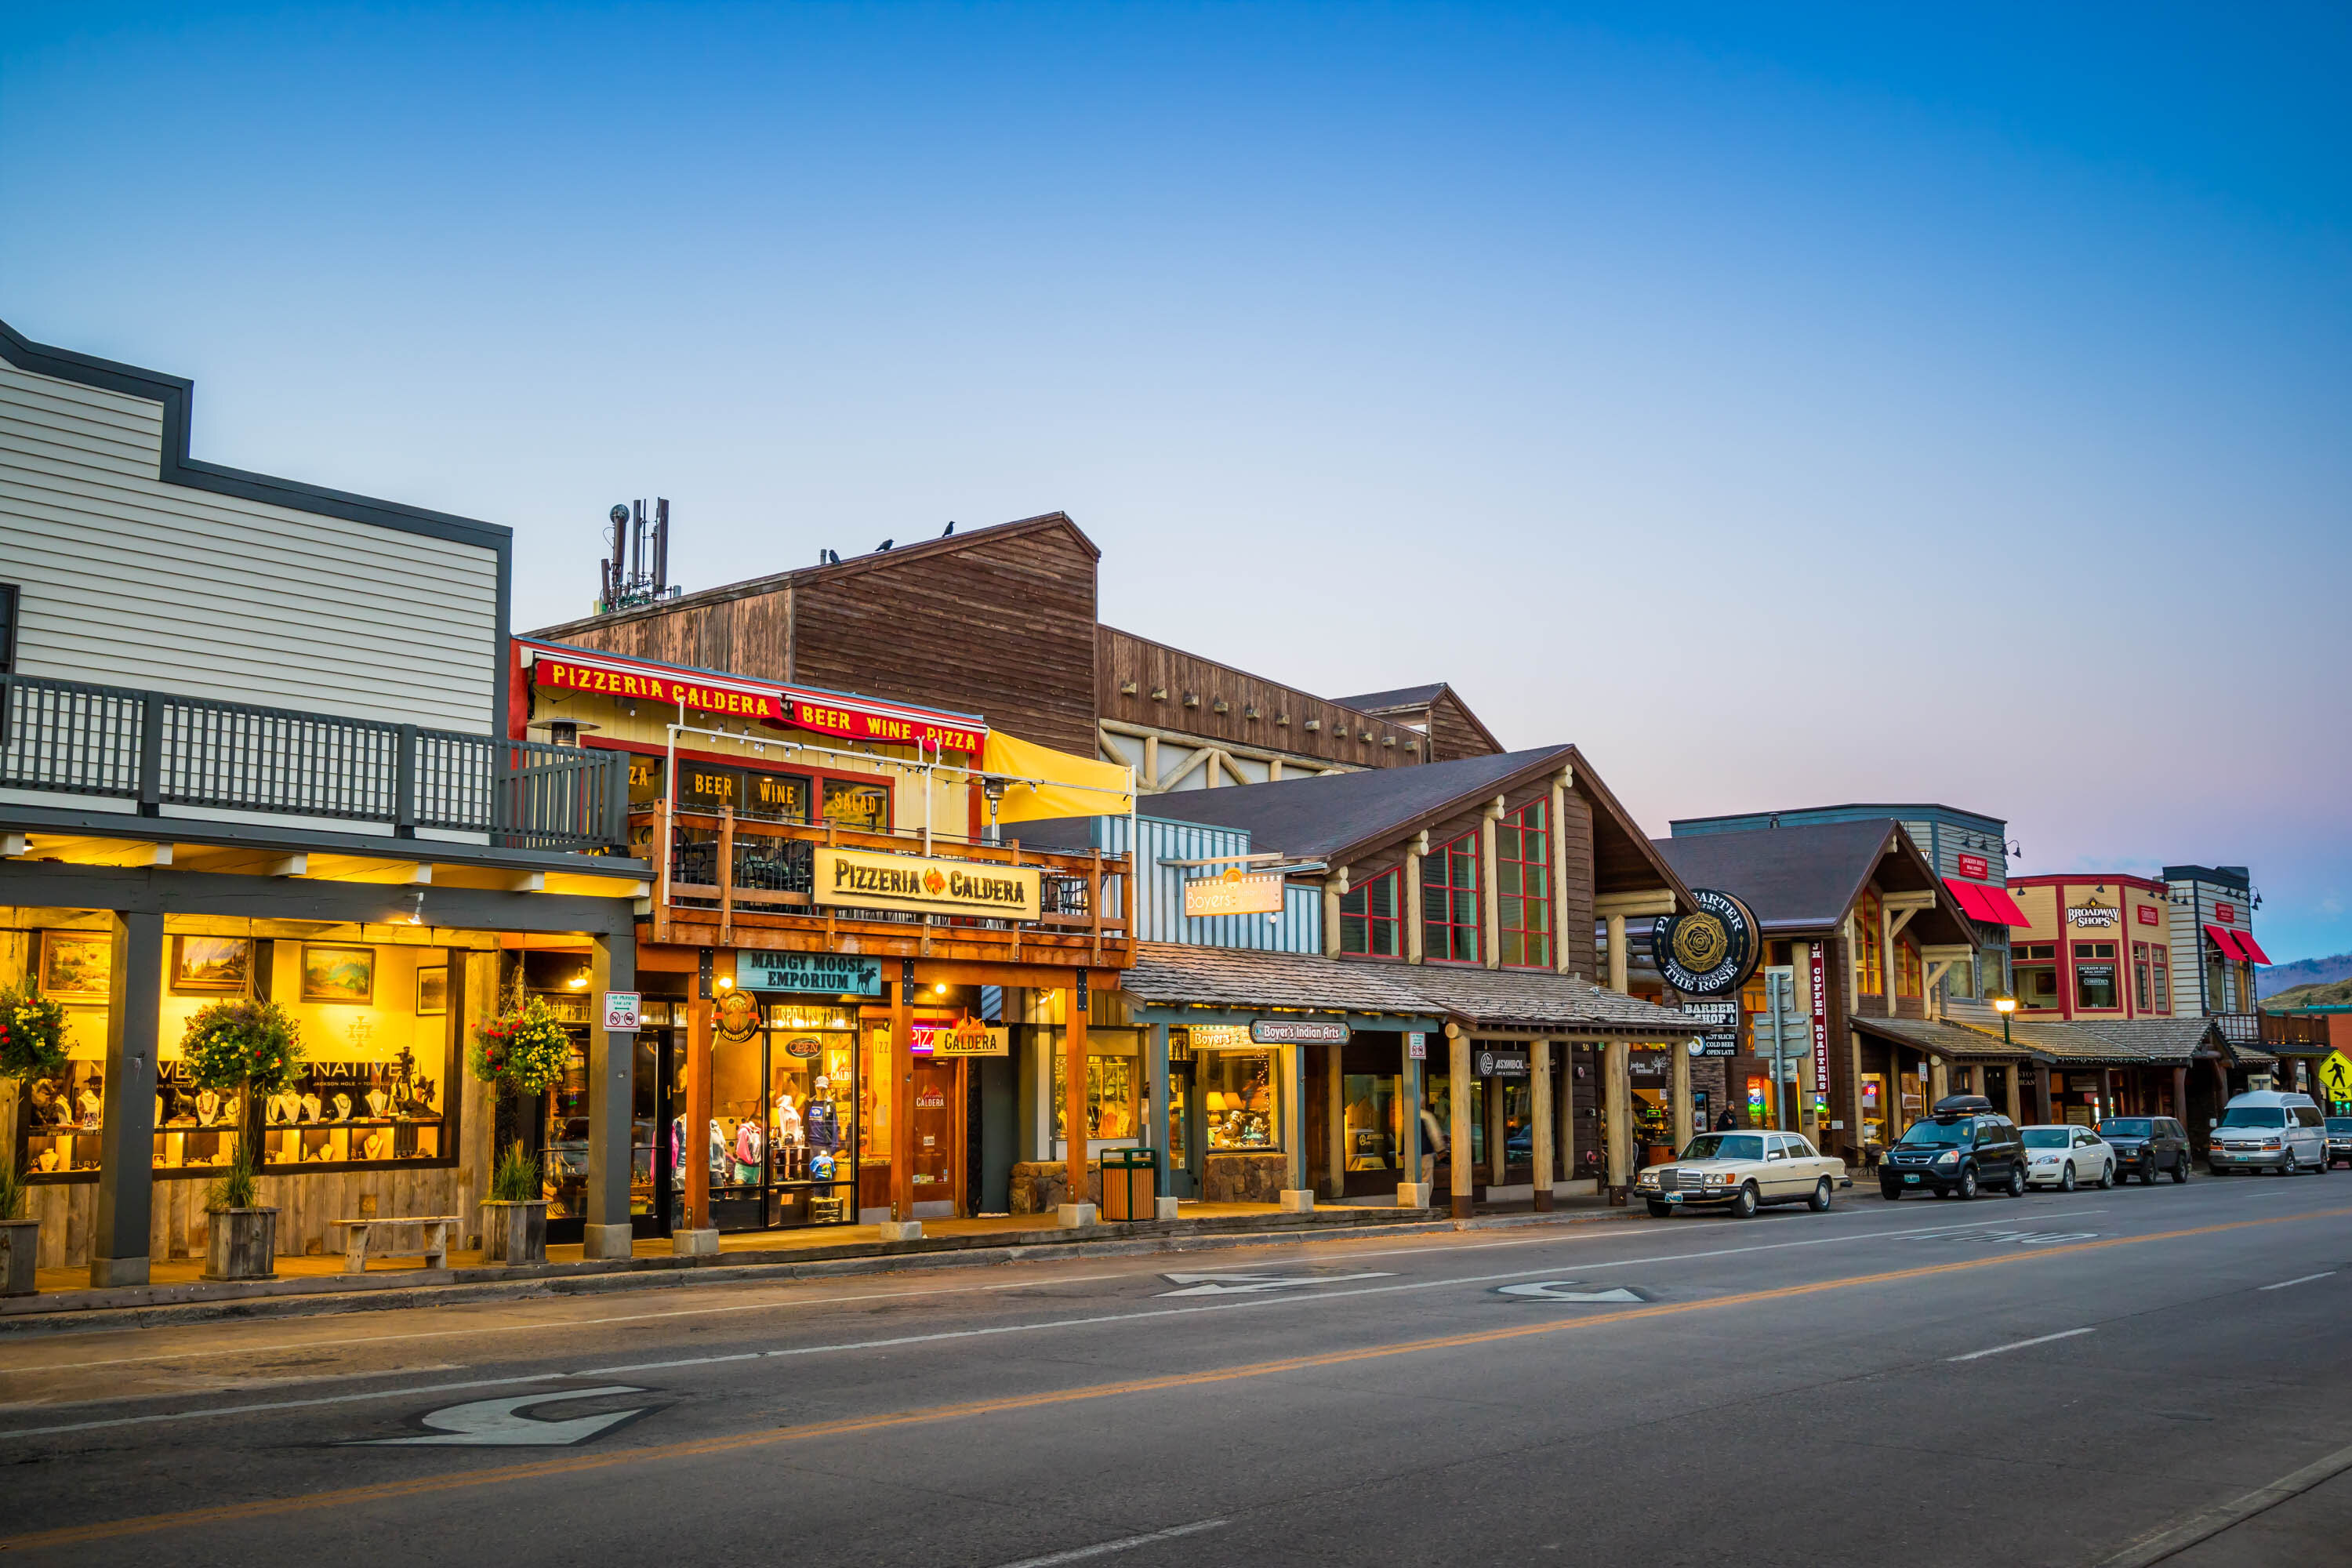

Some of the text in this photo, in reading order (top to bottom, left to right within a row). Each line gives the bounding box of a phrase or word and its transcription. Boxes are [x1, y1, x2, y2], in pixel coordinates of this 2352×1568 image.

[553, 664, 770, 716] PIZZERIA CALDERA
[802, 706, 976, 751] BEER WINE PIZZA
[695, 773, 732, 797] BEER
[760, 783, 794, 804] WINE
[834, 792, 877, 814] SALAD
[835, 858, 1025, 902] PIZZERIA CALDERA
[1186, 890, 1230, 912] Boyer's
[2067, 908, 2120, 924] BROADWAY
[2078, 916, 2111, 927] SHOPS
[1813, 943, 1821, 958] JH
[751, 953, 866, 973] MANGY MOOSE
[768, 971, 849, 989] EMPORIUM
[1664, 964, 1737, 992] THE ROSE
[1813, 967, 1824, 1015] COFFEE
[1685, 1004, 1735, 1014] BARBER
[722, 1029, 750, 1040] EMPORIUM
[1194, 1033, 1231, 1046] Boyer's
[1264, 1025, 1294, 1040] Boyer's
[1296, 1026, 1322, 1040] Indian
[1323, 1026, 1341, 1040] Arts
[789, 1042, 819, 1054] OPEN
[944, 1033, 997, 1051] CALDERA
[1495, 1060, 1523, 1069] ASYMBOL
[1815, 1025, 1827, 1090] ROASTERS
[916, 1098, 944, 1107] CALDERA
